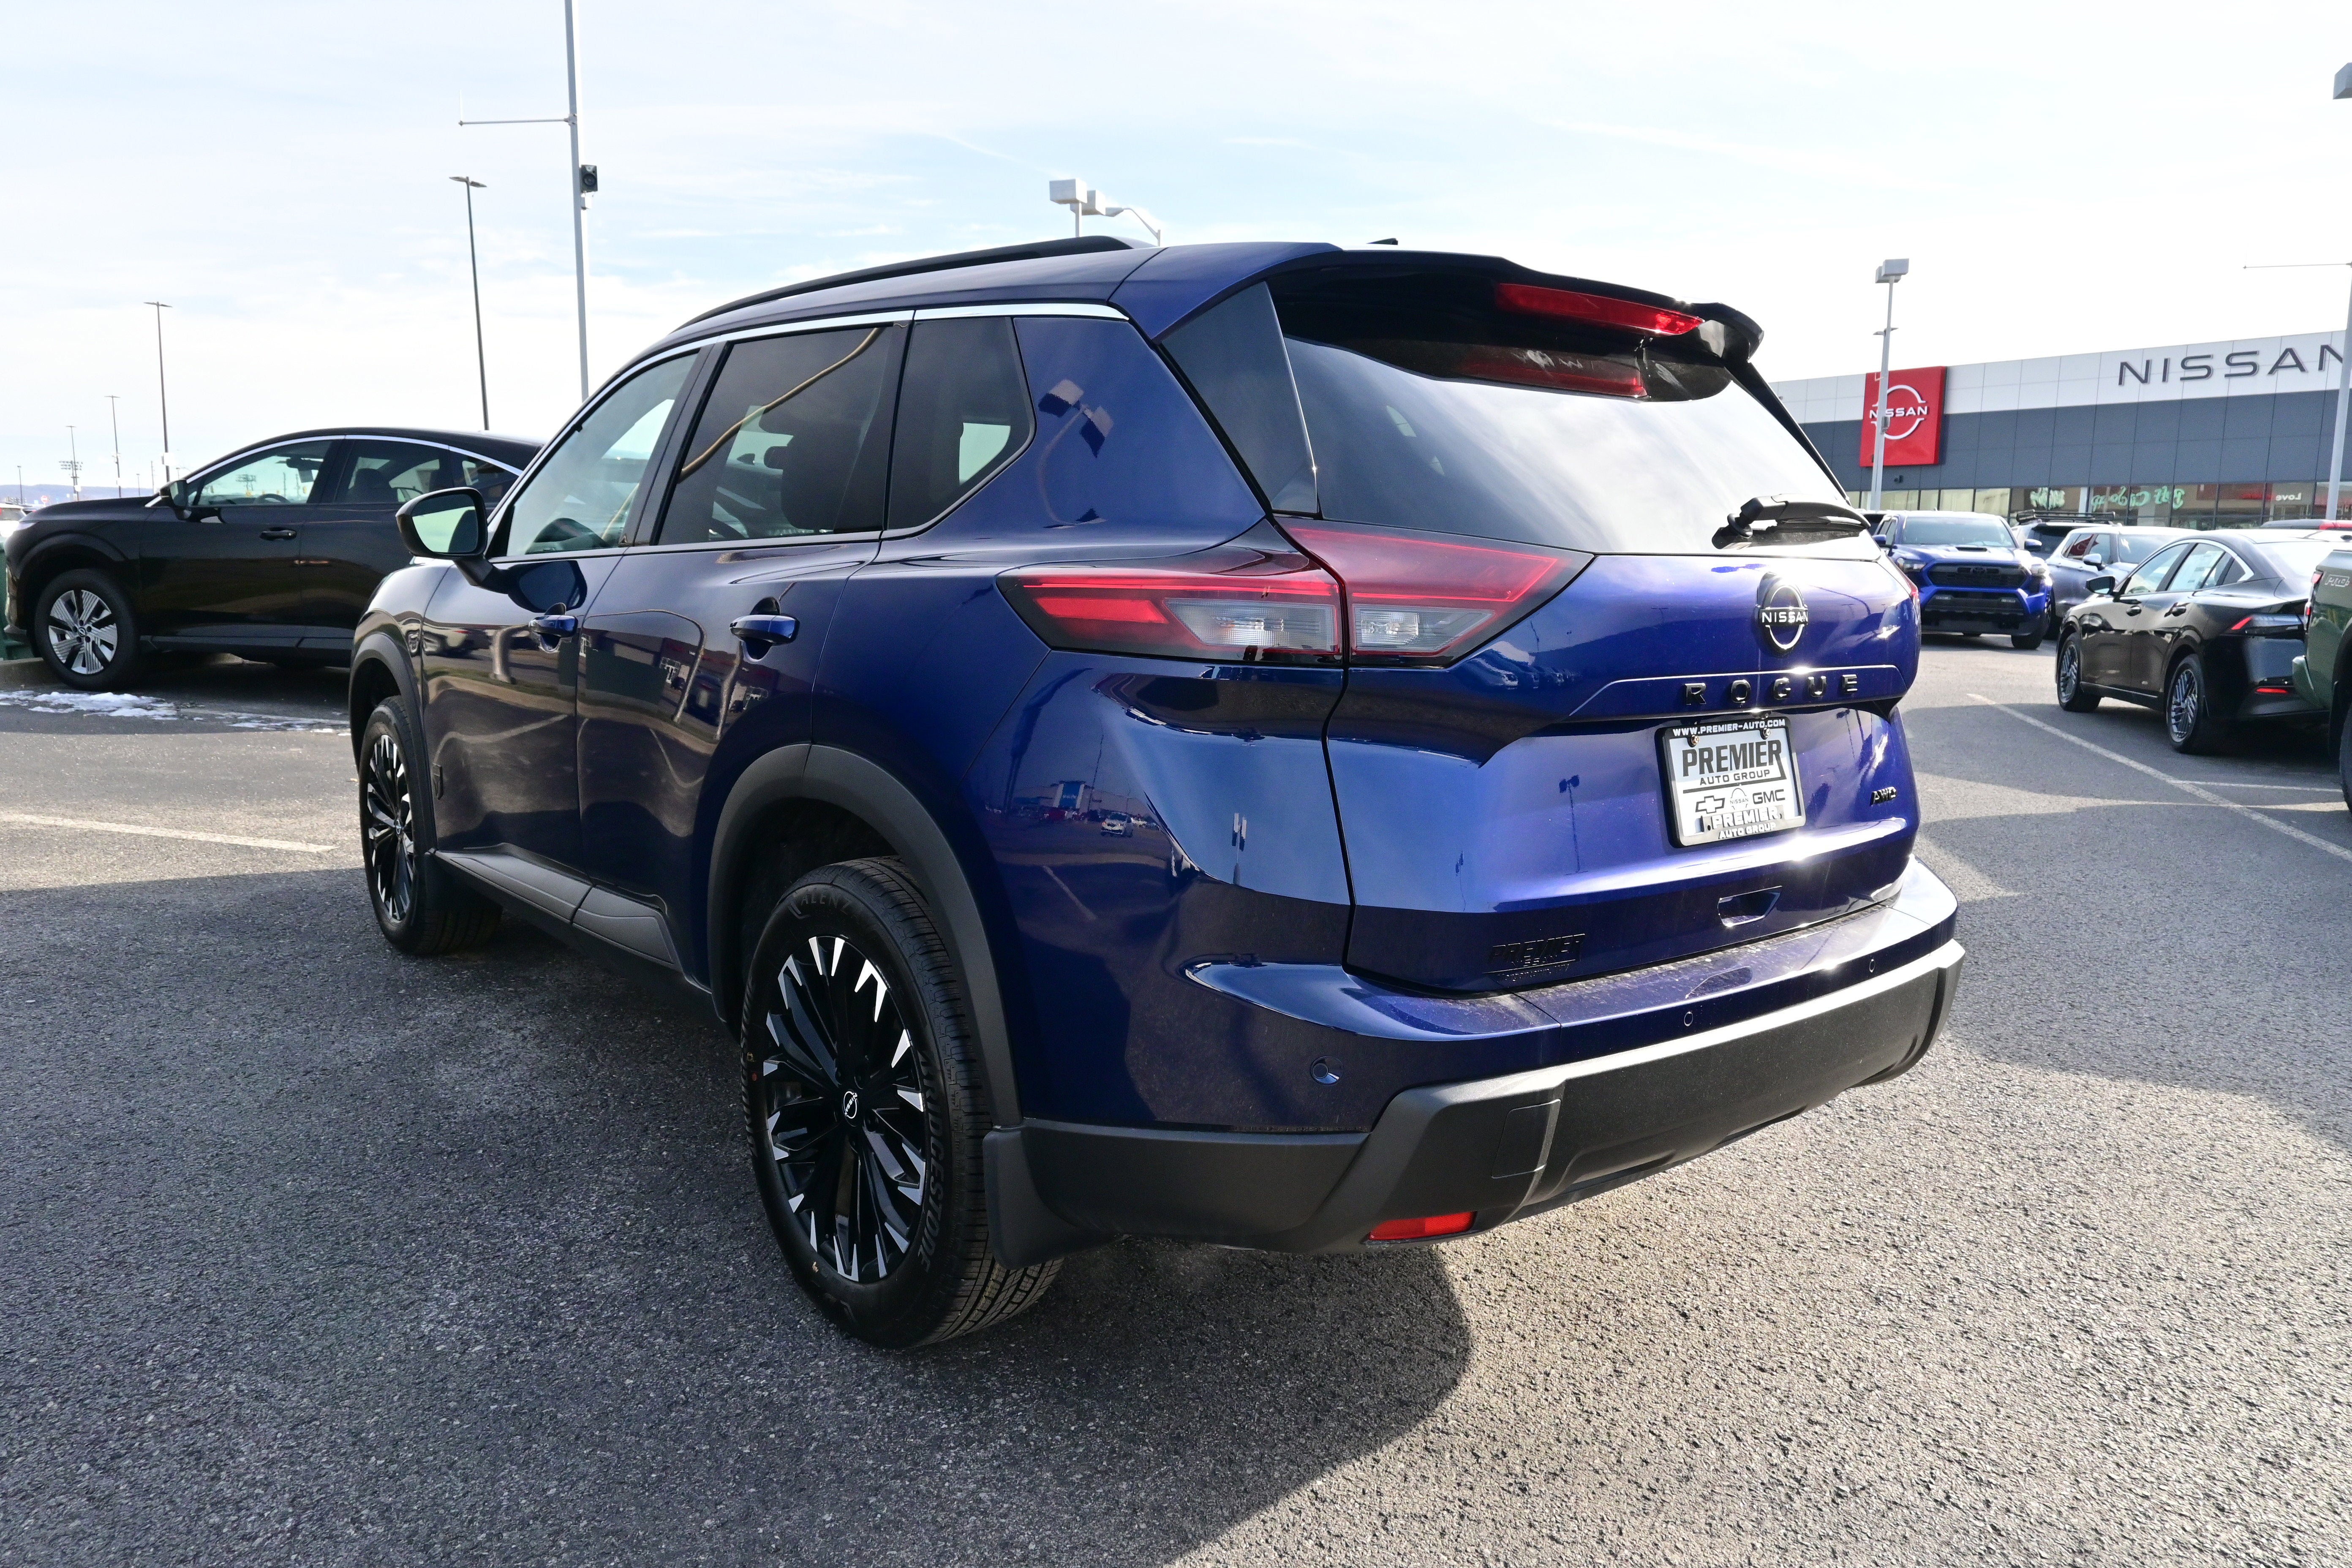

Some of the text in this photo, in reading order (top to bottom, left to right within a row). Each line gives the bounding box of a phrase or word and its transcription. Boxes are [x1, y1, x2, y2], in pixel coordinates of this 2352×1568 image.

[2118, 344, 2343, 386] NISSAN
[1870, 406, 1927, 419] NSSAN
[1762, 611, 1808, 623] NISSAN
[1685, 674, 1858, 705] ROGUE
[1673, 719, 1785, 736] WWW.PREMIER-AUTO.COM
[1682, 739, 1785, 777] PREMIER
[1700, 769, 1770, 785] AUTO GROUP
[1753, 789, 1785, 804] GMC
[1870, 787, 1896, 806] AWD
[1711, 806, 1778, 830] PREMIER
[1718, 822, 1776, 839] AUTO GROUP
[917, 1050, 945, 1273] BRIDGESTONE
